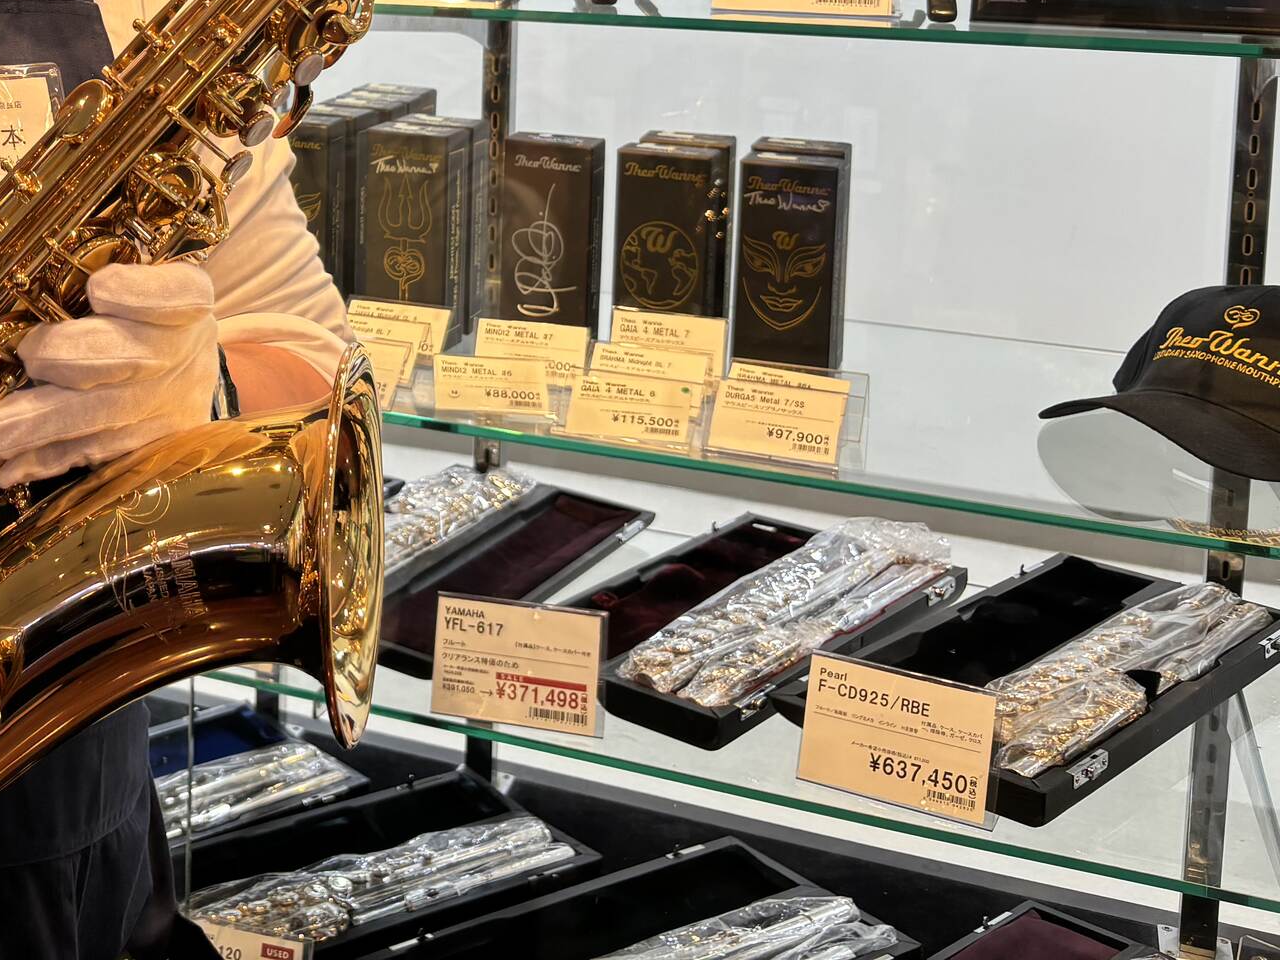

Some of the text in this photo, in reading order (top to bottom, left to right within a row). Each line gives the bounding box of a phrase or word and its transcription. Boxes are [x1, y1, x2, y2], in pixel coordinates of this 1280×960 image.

[514, 330, 539, 339] METAL
[620, 324, 637, 333] GAIA
[653, 328, 679, 338] METAL
[1159, 327, 1207, 350] Theo
[1184, 350, 1237, 370] SAXOPHONE
[472, 368, 497, 376] METAL
[485, 388, 535, 400] ¥88,000
[580, 385, 600, 393] GAIA
[616, 388, 645, 397] METAL
[760, 396, 780, 406] Metal
[784, 399, 805, 409] 7/SS
[612, 414, 674, 427] ¥115,500
[767, 427, 823, 445] ¥97,900
[445, 605, 485, 619] YAMAHA
[444, 617, 504, 637] YFL-617
[441, 652, 520, 670] クリアランス特価のため
[820, 667, 848, 682] Pearl
[496, 681, 579, 710] ¥371,498
[818, 679, 931, 718] F-CD925/RBE
[869, 752, 968, 794] ¥637,450
[266, 948, 289, 959] USED
